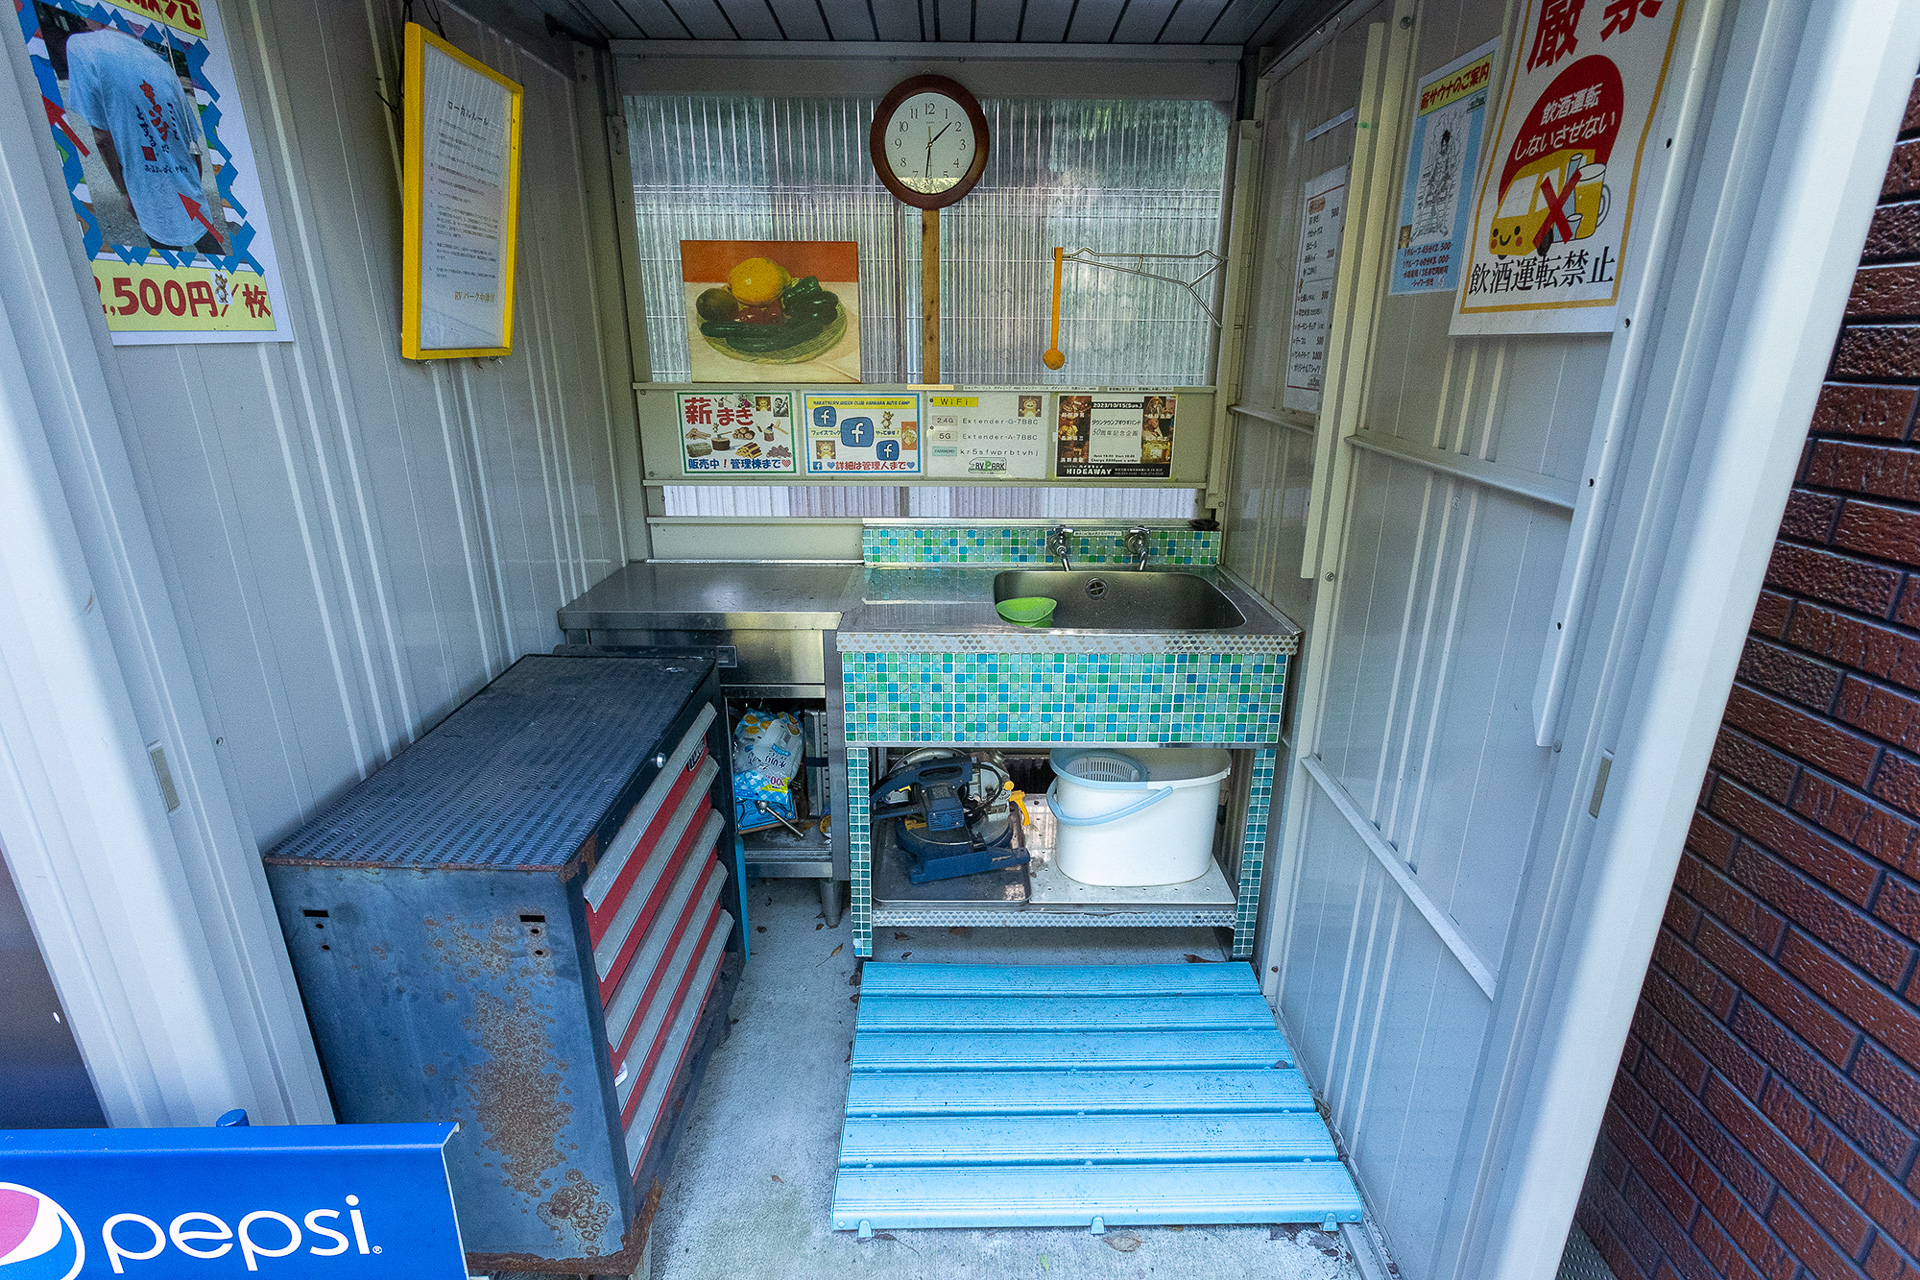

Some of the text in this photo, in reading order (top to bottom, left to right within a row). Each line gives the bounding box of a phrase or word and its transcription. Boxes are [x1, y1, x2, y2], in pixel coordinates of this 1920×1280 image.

[924, 102, 936, 115] 12
[1540, 82, 1603, 126] 飲酒運転
[909, 108, 918, 119] 11
[944, 108, 948, 119] 1
[899, 121, 909, 132] 10
[954, 121, 962, 132] 2
[1514, 111, 1616, 161] しないさせない
[894, 138, 902, 150] 9
[959, 138, 966, 151] 3
[900, 157, 907, 167] 8
[952, 158, 960, 168] 4
[1467, 245, 1616, 296] 飲酒運転禁止
[940, 398, 969, 406] WiFi
[684, 397, 754, 426] 薪 まき
[939, 432, 951, 440] 5G
[730, 459, 781, 470] 管理棟まで
[835, 461, 907, 470] 詳細は管理人まで
[102, 1194, 370, 1274] pepsi
